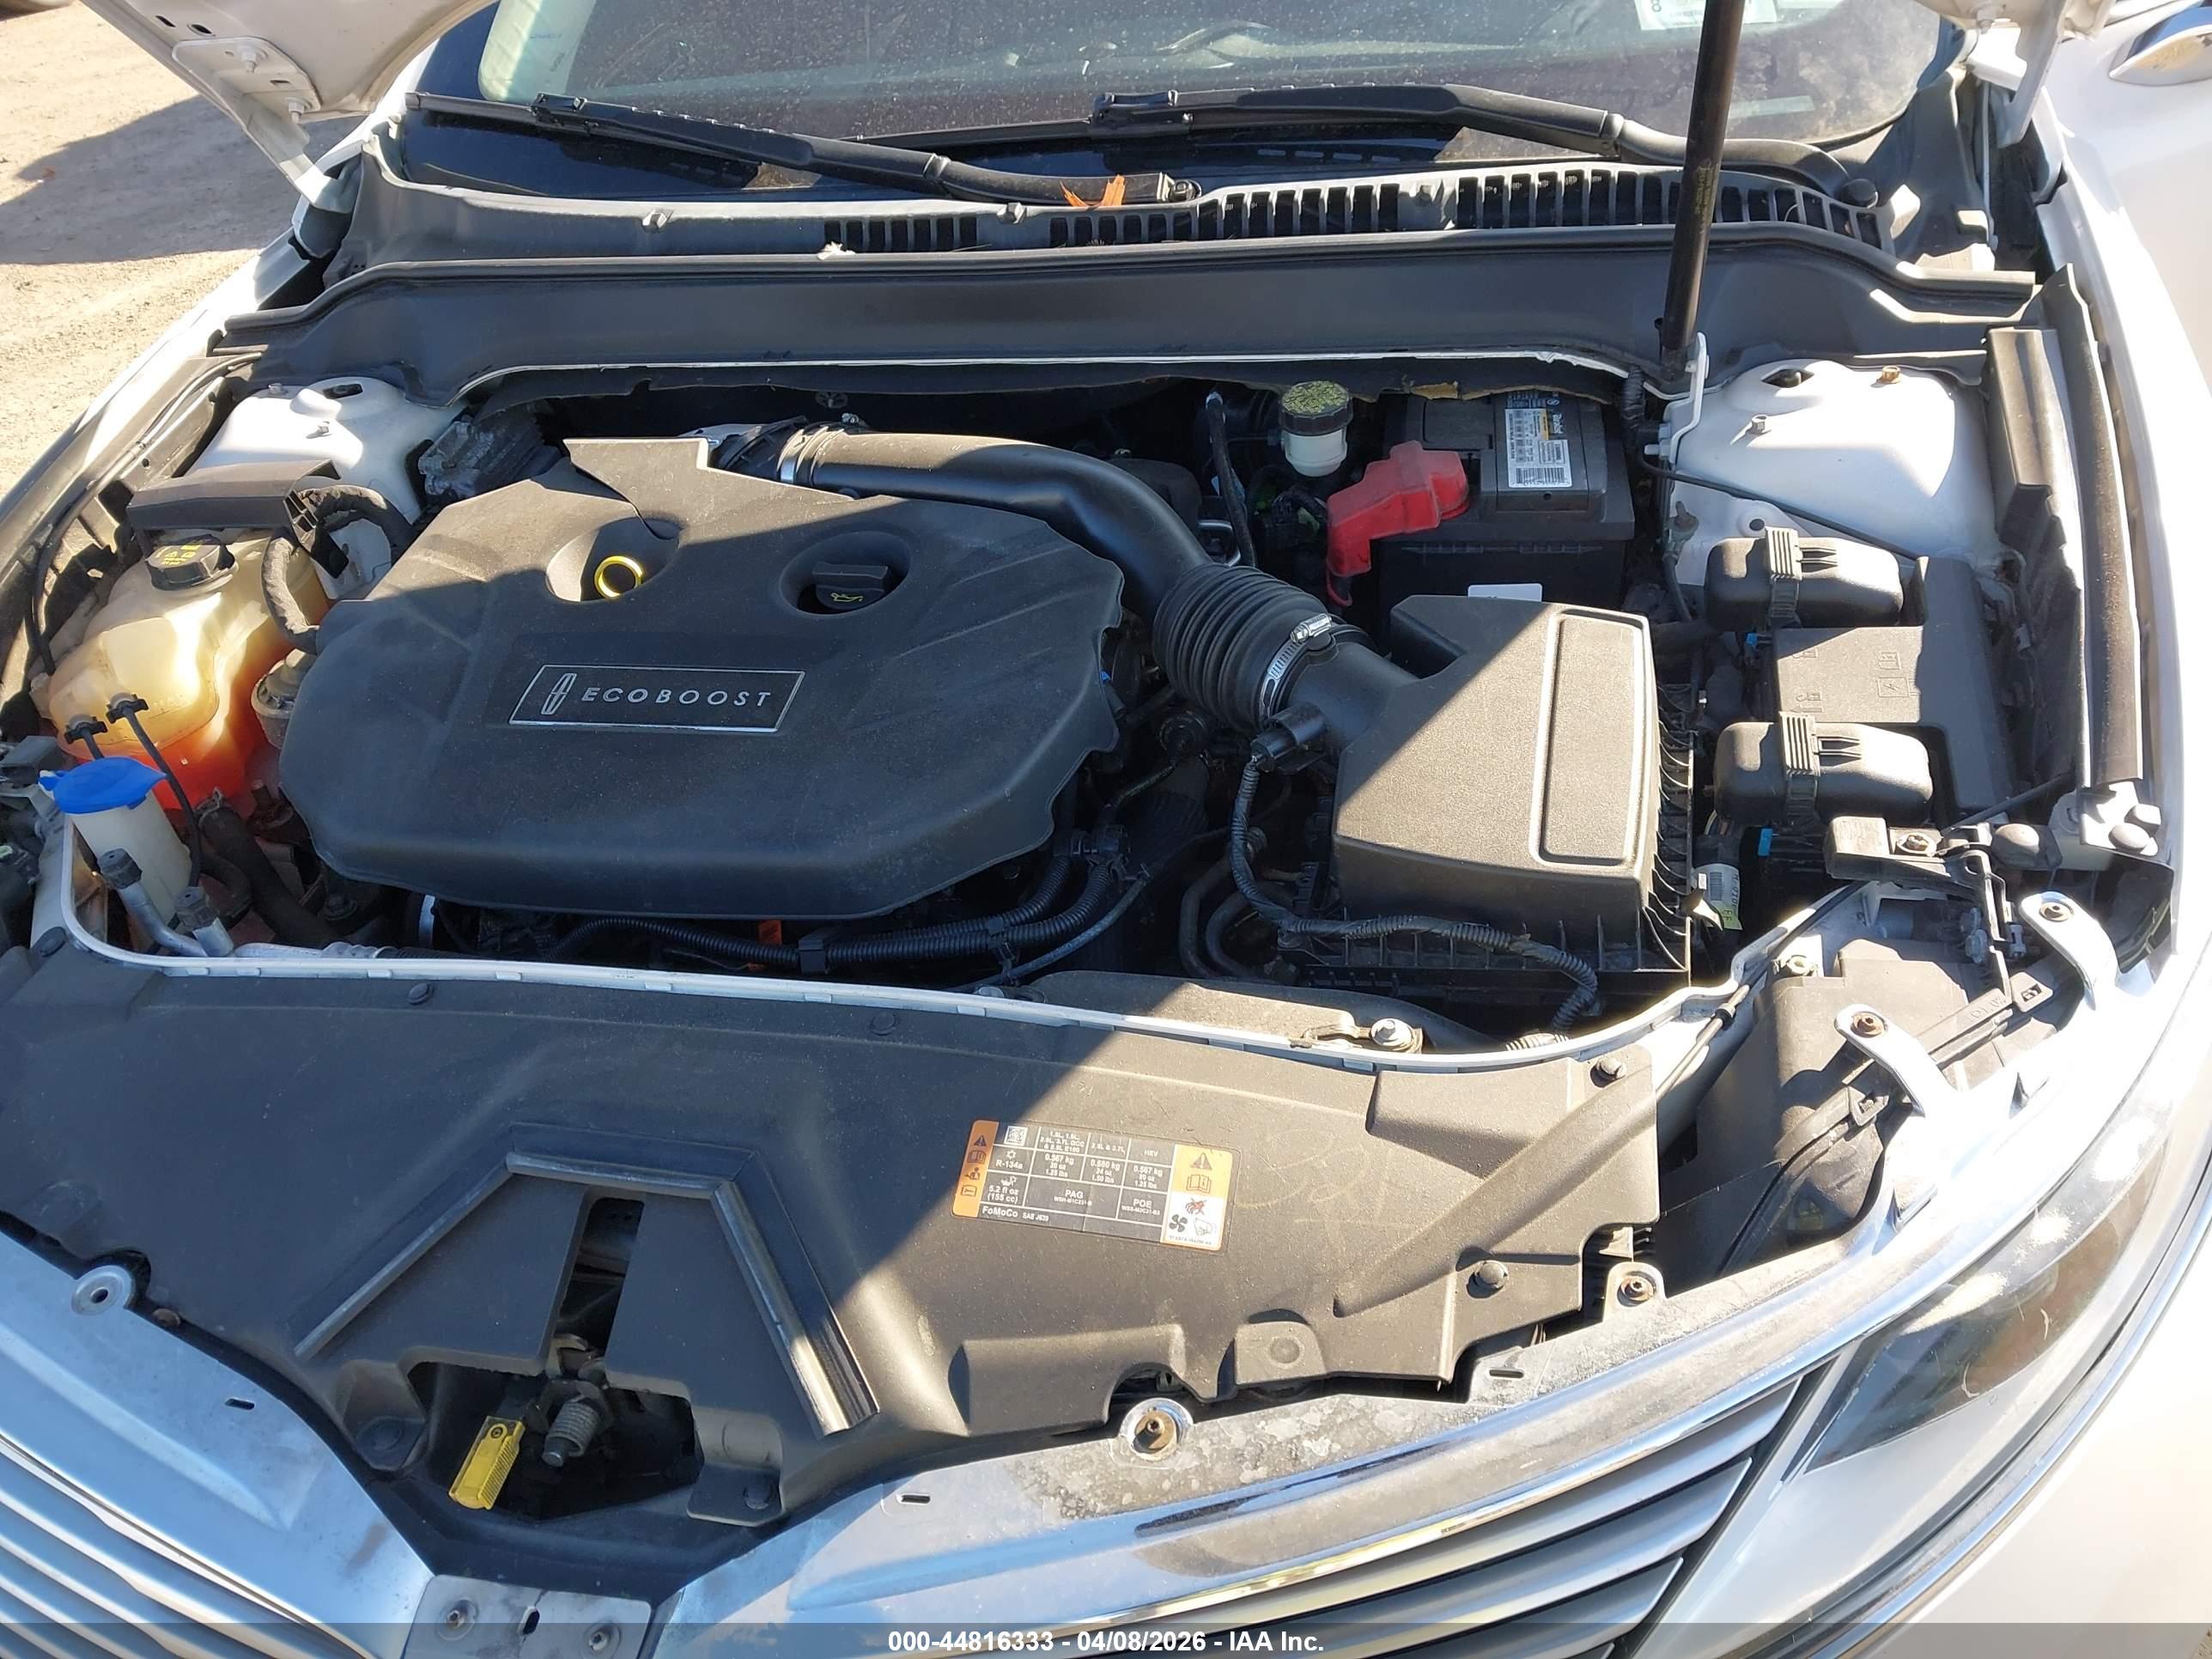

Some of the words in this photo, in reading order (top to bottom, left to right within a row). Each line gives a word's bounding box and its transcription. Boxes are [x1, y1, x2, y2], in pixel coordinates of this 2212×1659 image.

[580, 686, 773, 708] ECOBOOST
[995, 1159, 1024, 1170] R-134a
[988, 1193, 1006, 1201] (155
[1006, 1194, 1018, 1204] cc)
[1065, 1188, 1084, 1199] PAG
[1133, 1198, 1152, 1209] POE
[981, 1206, 1018, 1218] FoMoCo
[1022, 1212, 1035, 1220] SAE
